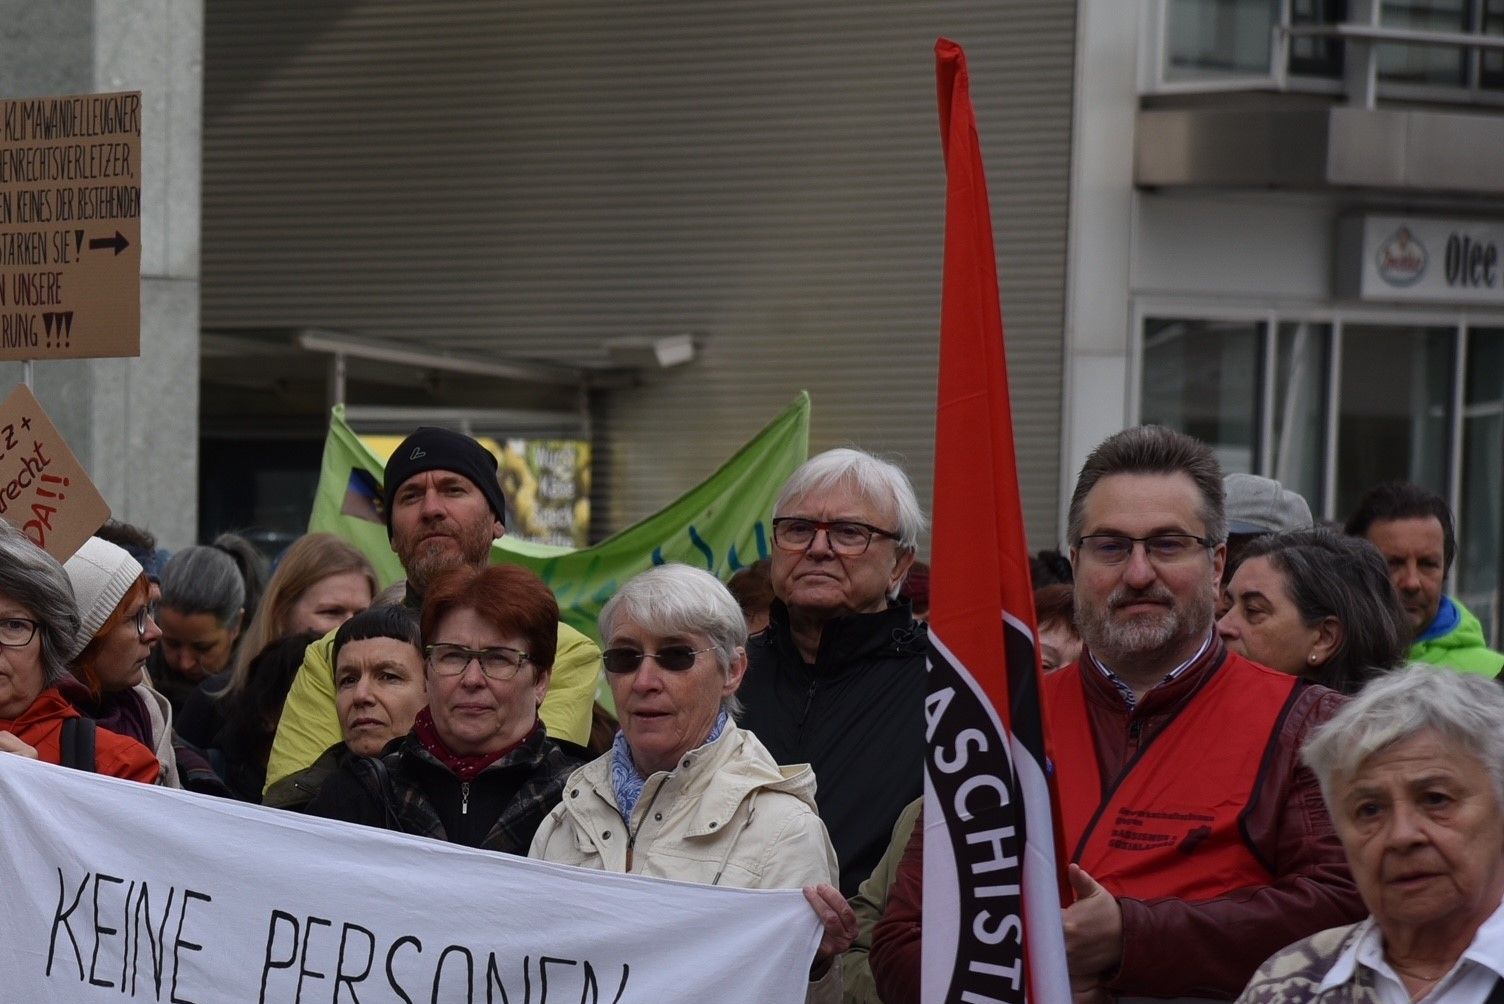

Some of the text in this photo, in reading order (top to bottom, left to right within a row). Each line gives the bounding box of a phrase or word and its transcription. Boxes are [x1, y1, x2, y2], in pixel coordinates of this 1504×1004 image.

[17, 189, 52, 222] KEINES
[56, 188, 74, 221] DER
[78, 186, 141, 220] BESTEHENDEN
[13, 272, 63, 306] UNSERE
